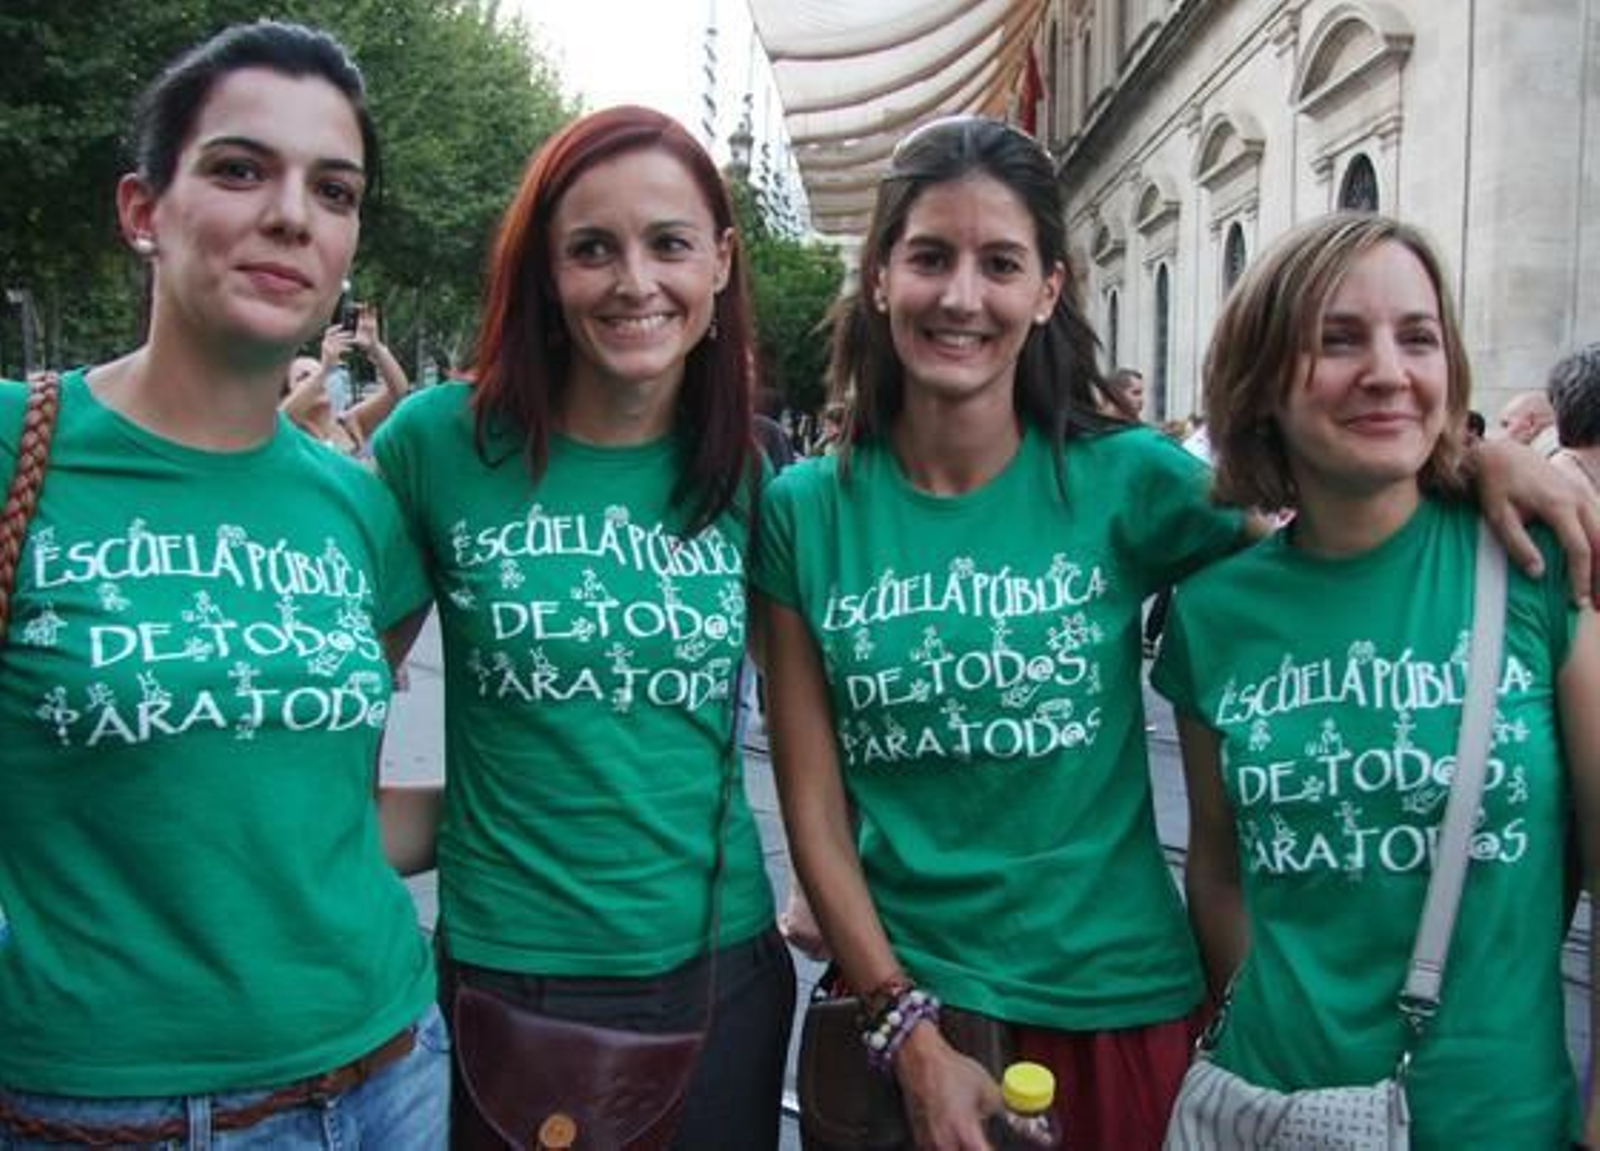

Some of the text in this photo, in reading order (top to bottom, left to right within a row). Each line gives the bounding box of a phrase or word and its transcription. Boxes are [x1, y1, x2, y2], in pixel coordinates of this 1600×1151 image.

[492, 602, 572, 639] DE
[90, 623, 190, 668] DE
[847, 650, 1087, 711] DE TOD@S
[1238, 762, 1305, 805] DE
[1345, 818, 1527, 872] TO@S
